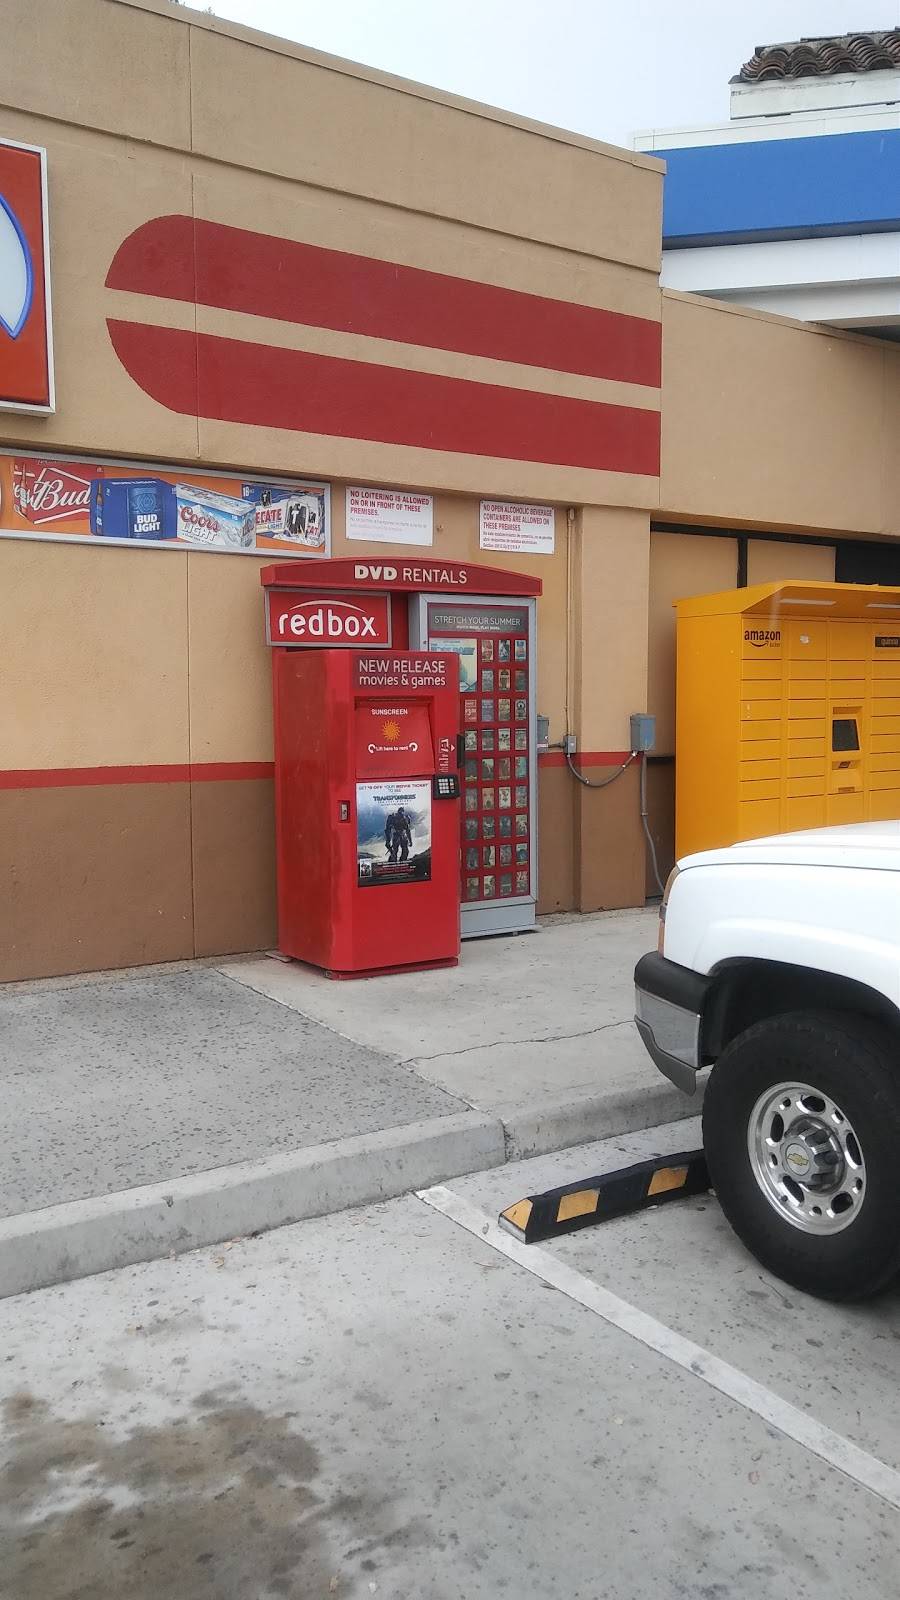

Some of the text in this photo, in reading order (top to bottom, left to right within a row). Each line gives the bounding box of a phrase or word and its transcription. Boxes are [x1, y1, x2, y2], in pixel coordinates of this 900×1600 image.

[350, 490, 360, 498] NO
[361, 491, 394, 501] LOITERING
[400, 496, 430, 505] ALLOWED
[361, 499, 369, 507] OR
[377, 501, 395, 509] FRONT
[404, 504, 421, 512] THESE
[491, 504, 504, 512] OPEN
[504, 506, 529, 515] ALCOHOLIC
[530, 508, 553, 517] BEVERAGE
[136, 514, 158, 524] BUD
[181, 506, 221, 533] Coors
[255, 508, 282, 524] ECATE
[483, 513, 512, 522] CONTAINERS
[513, 515, 521, 523] ARE
[522, 516, 542, 525] ALLOWED
[133, 522, 161, 533] LIGHT
[483, 521, 498, 530] THESE
[182, 523, 218, 542] LIGHT
[354, 564, 468, 584] DVD RENTALS
[278, 609, 377, 637] redbox
[434, 615, 521, 626] STRETCH YOUR SUMMER
[744, 630, 781, 641] amazon
[359, 660, 446, 673] NEW RELEASE
[359, 674, 446, 689] movies & games
